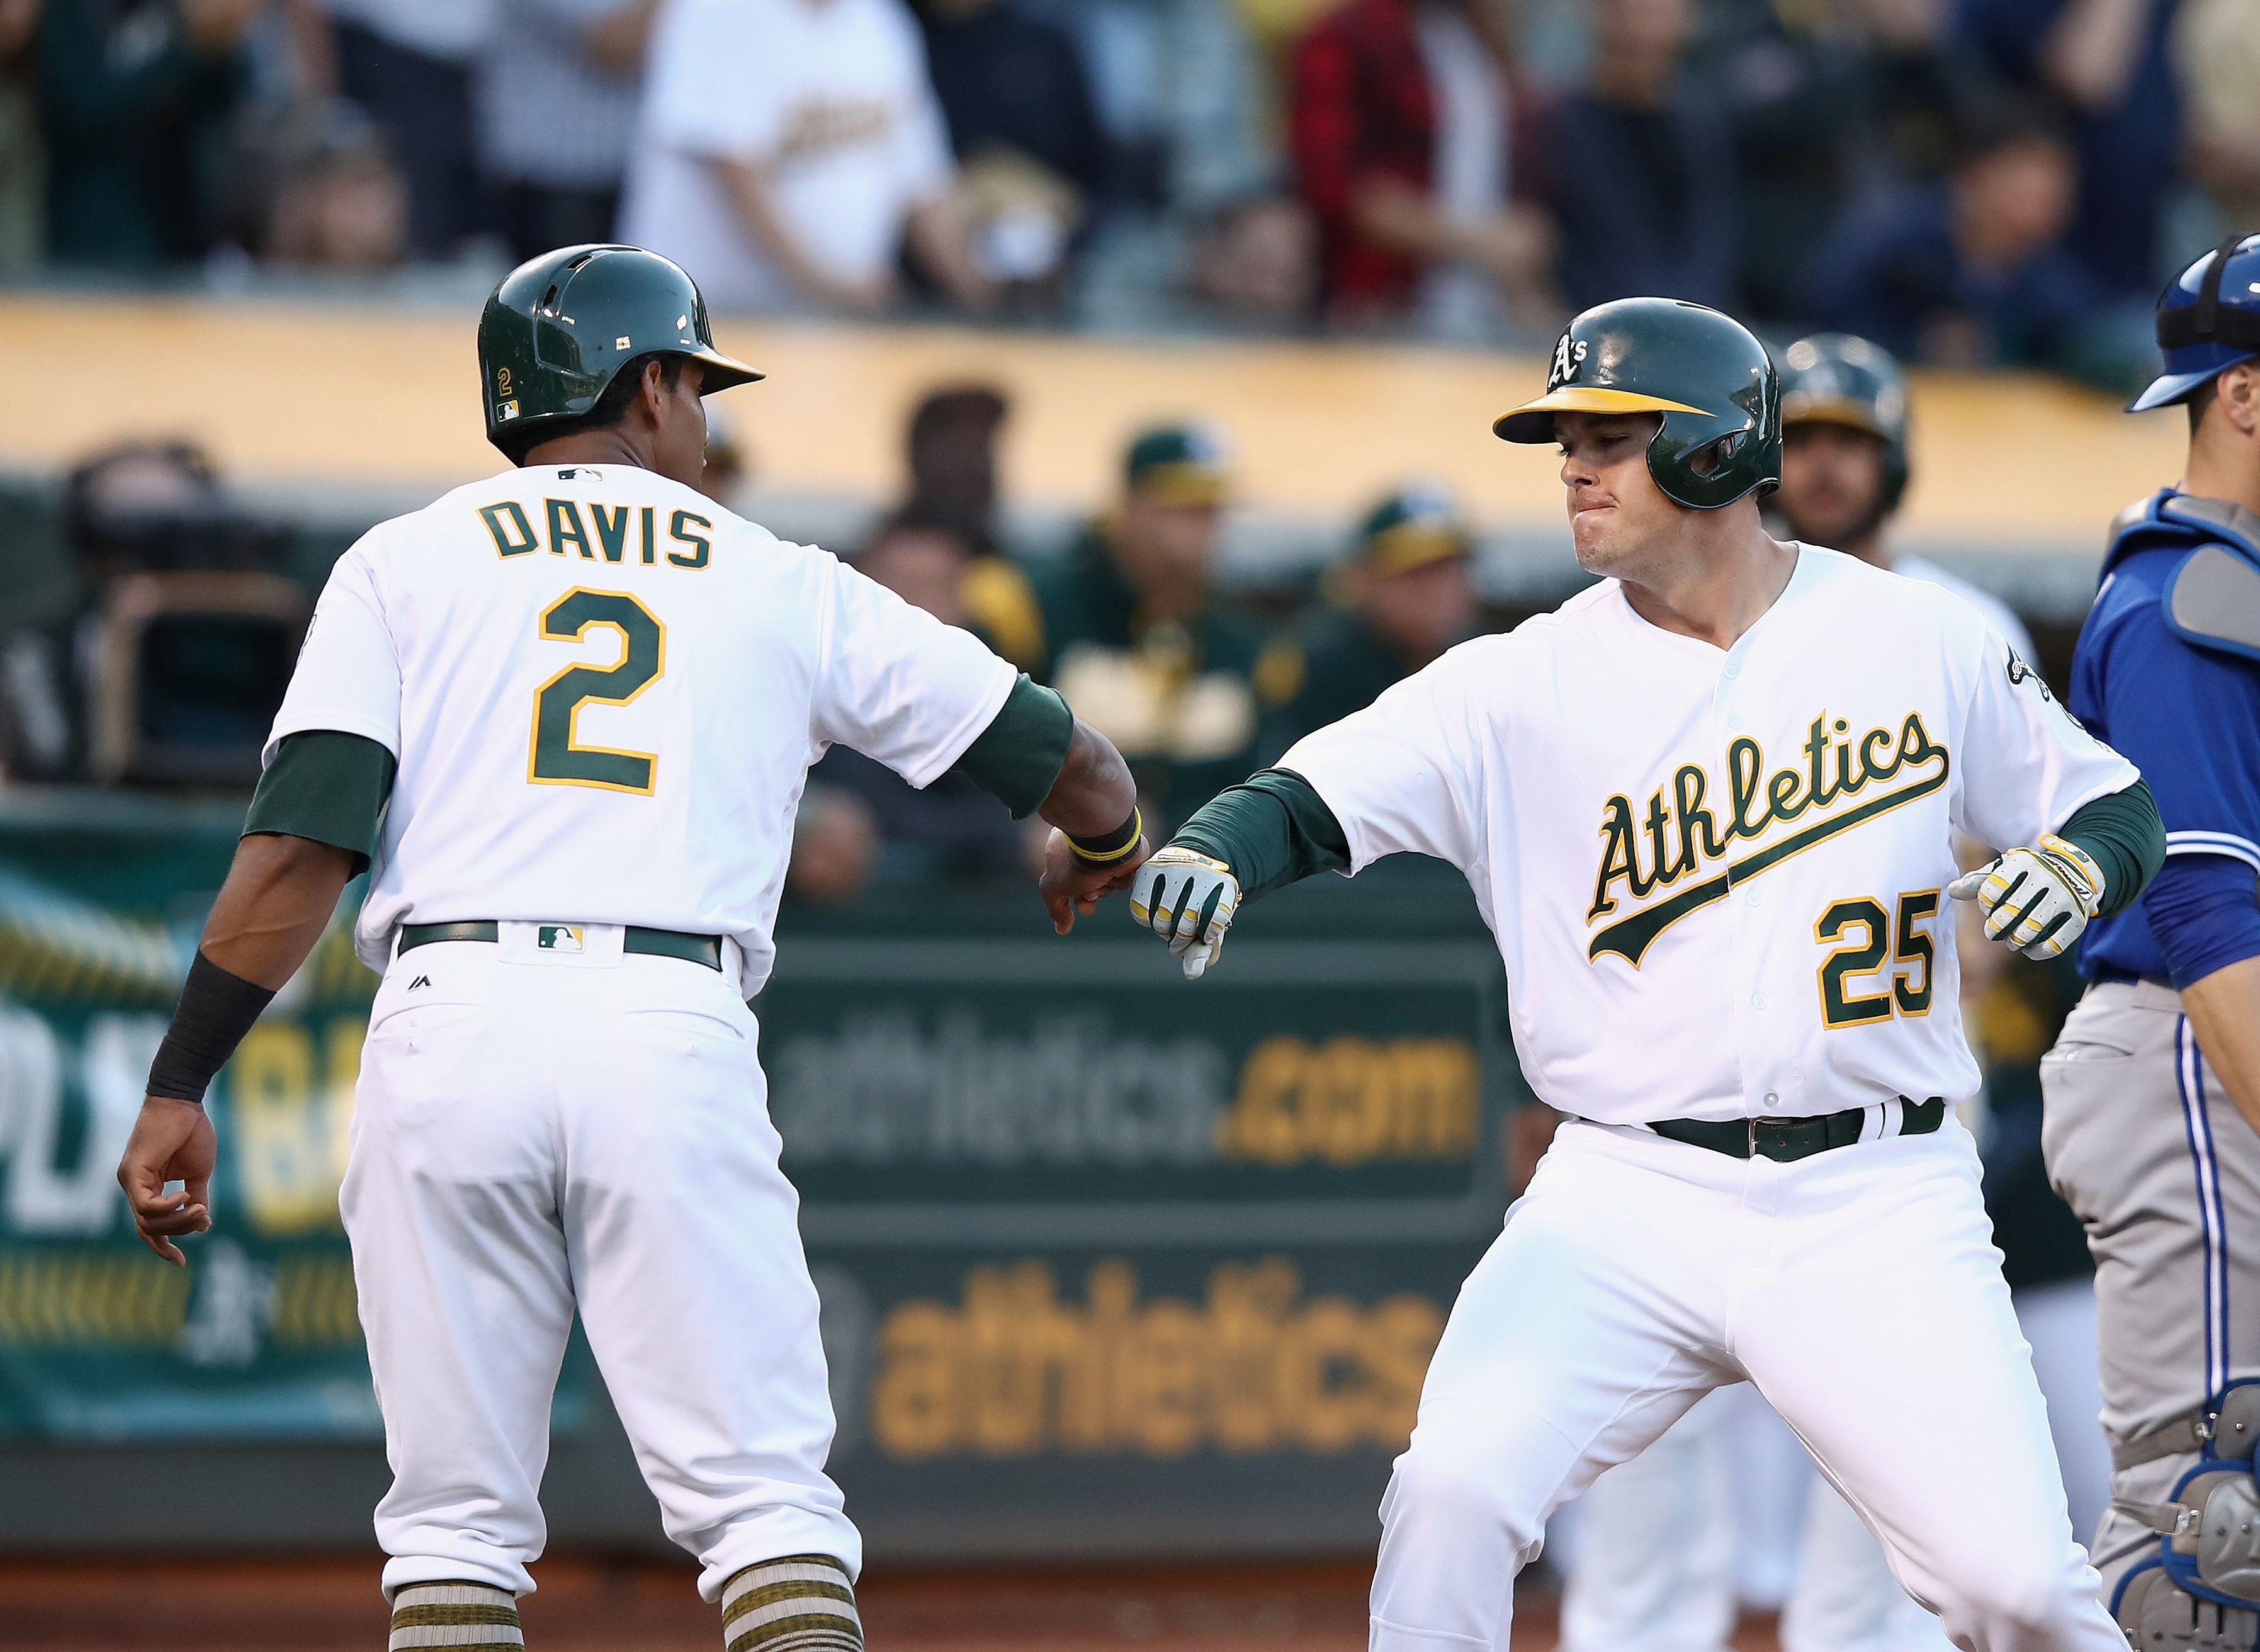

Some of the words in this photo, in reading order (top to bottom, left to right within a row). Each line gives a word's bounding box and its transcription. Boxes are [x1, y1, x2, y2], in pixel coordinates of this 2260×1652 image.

[497, 368, 513, 397] 2
[1548, 334, 1588, 388] A's
[475, 497, 714, 571] DAVIS
[527, 585, 667, 796] 2
[1586, 708, 1950, 929] Athletics
[1813, 888, 1941, 1031] 25
